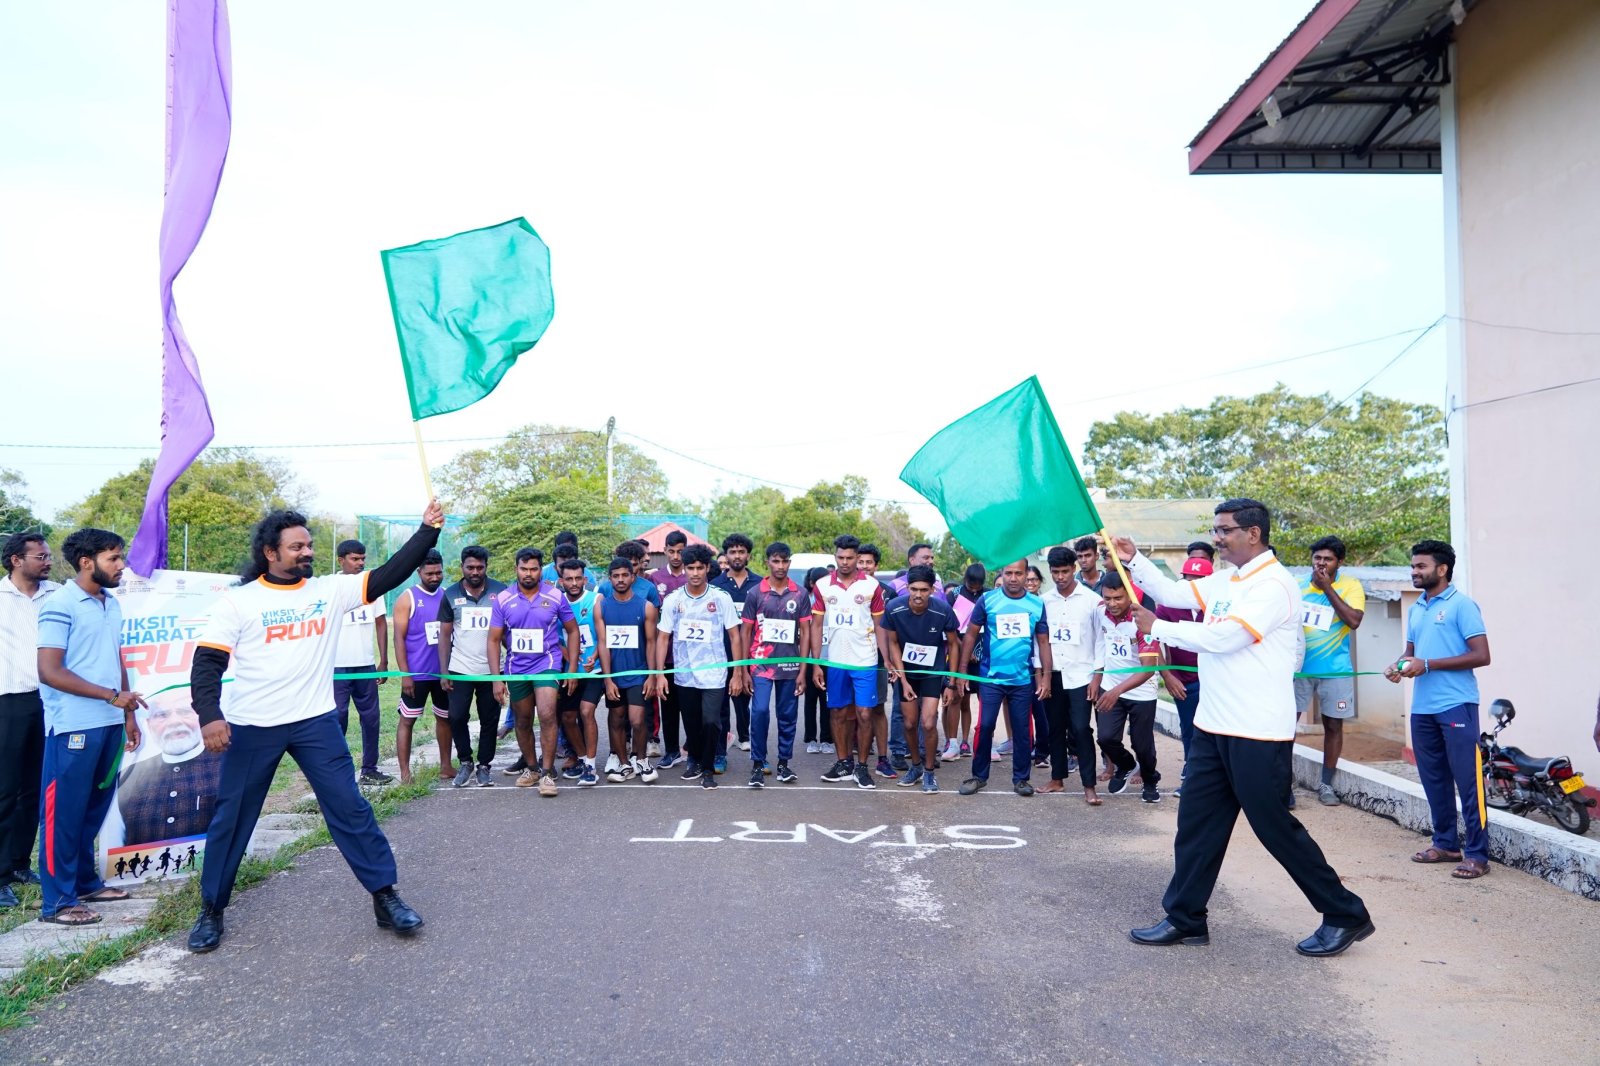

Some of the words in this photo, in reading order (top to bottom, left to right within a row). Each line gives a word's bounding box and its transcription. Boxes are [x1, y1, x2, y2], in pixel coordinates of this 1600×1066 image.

[261, 608, 296, 619] VIKSIT
[262, 613, 306, 627] BHARAT
[350, 610, 368, 623] 14
[835, 613, 854, 626] 04
[1303, 611, 1321, 626] 11
[471, 616, 489, 628] 10
[264, 617, 327, 644] RUN
[685, 627, 705, 640] 22
[770, 628, 789, 641] 26
[1001, 622, 1022, 636] 35
[1053, 628, 1072, 642] 43
[517, 638, 534, 651] 01
[611, 634, 630, 646] 27
[1111, 643, 1128, 657] 36
[907, 651, 928, 663] 07
[629, 818, 1028, 850] START
